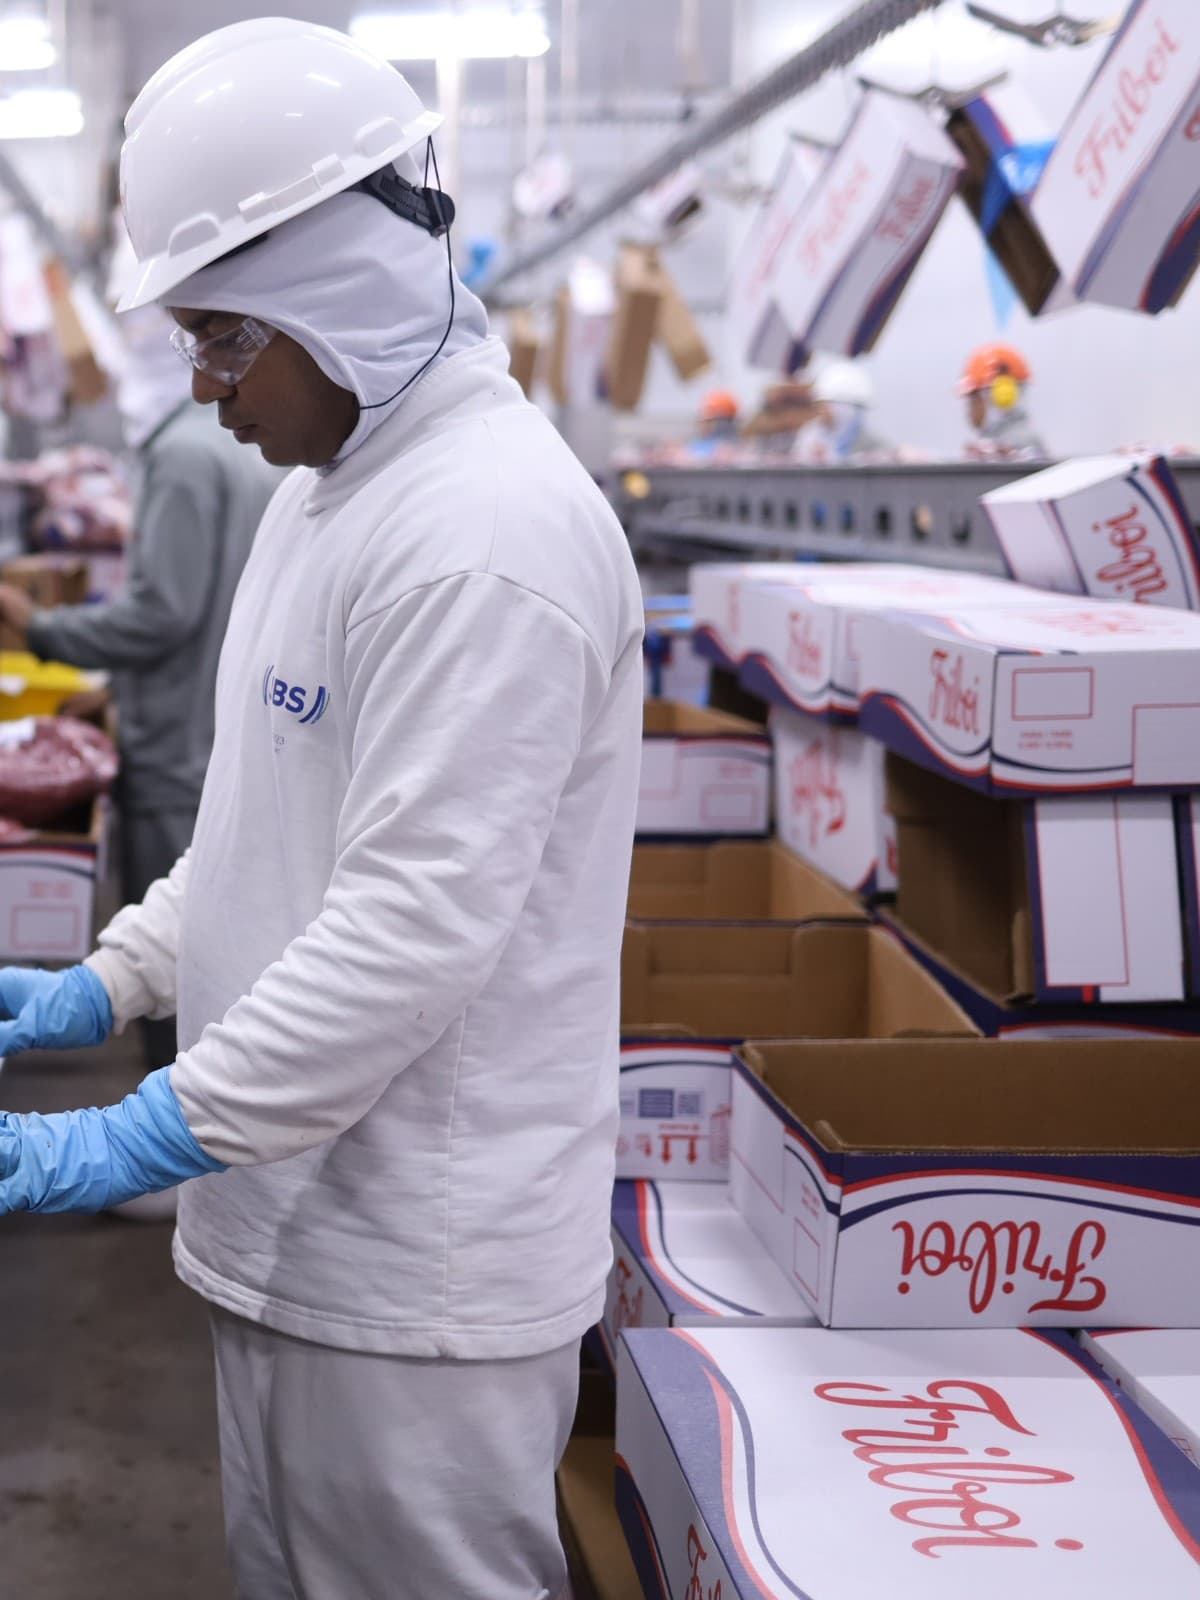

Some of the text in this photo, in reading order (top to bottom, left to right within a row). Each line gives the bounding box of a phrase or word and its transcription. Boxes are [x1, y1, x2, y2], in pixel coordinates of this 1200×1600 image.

[1091, 504, 1168, 605] riboi
[930, 648, 981, 735] Friboi
[892, 1220, 1106, 1314] Friboi
[813, 1380, 1084, 1559] Friboi
